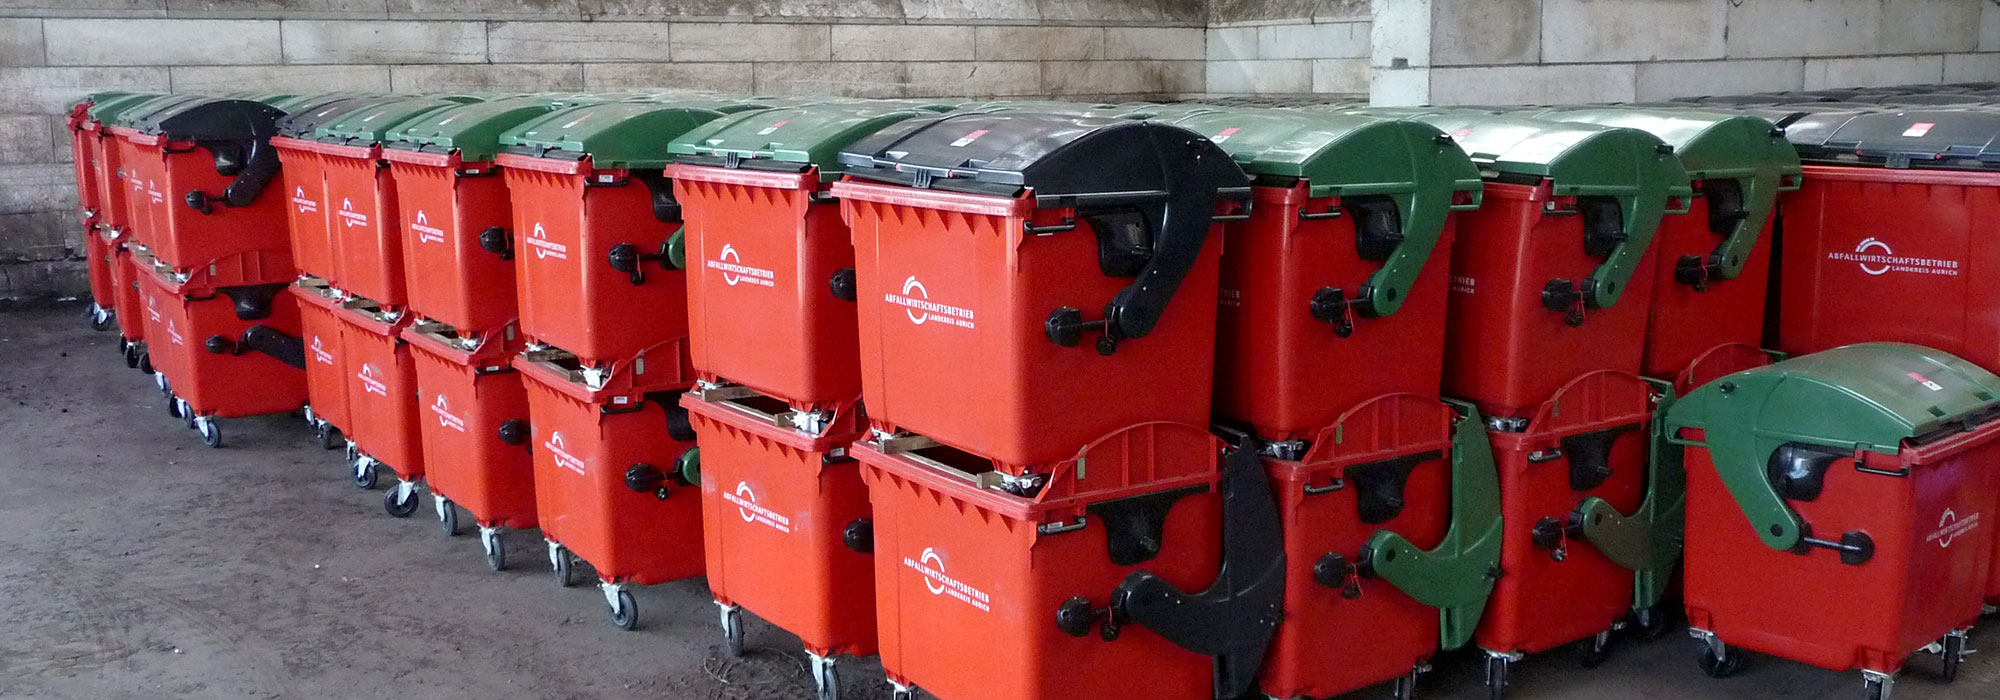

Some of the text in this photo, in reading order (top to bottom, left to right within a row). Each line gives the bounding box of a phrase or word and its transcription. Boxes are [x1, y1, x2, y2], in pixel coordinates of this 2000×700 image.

[1828, 252, 1958, 268] ABFALLWIRTSCHAFTSBETRIEB
[1892, 266, 1958, 276] LANDKREIS AURICH
[884, 293, 974, 319] ABFALLWIRTSCHAFTSBETRIEB
[928, 313, 955, 325] LANDKREIS
[903, 557, 990, 603] ABFALLWIRTSCHAFTSBETRIEB
